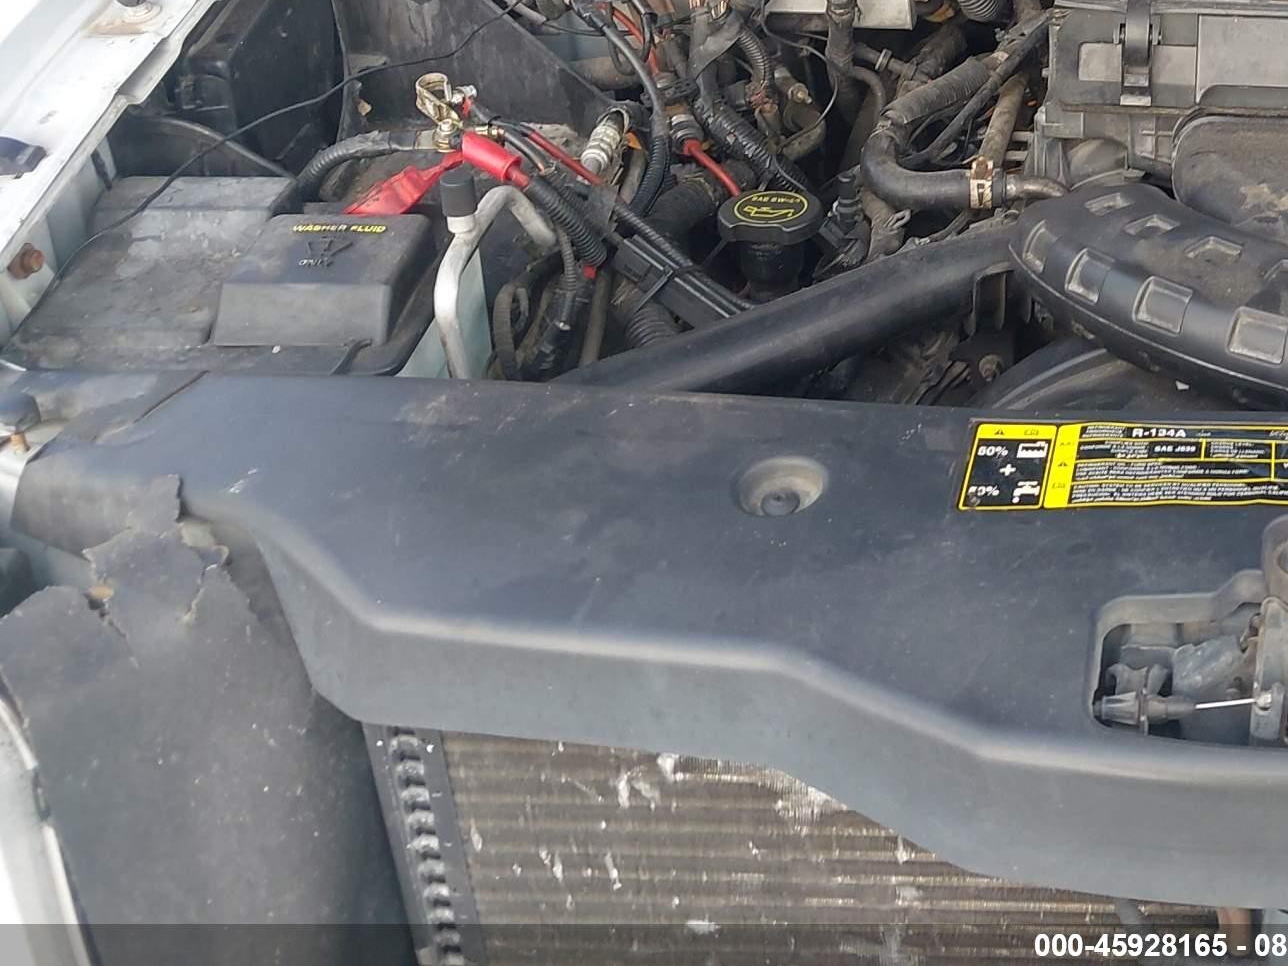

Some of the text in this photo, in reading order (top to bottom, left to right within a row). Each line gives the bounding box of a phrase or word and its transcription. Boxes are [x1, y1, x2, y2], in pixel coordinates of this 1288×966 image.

[292, 224, 387, 233] WASHER FLUID
[1131, 428, 1187, 438] R-134A
